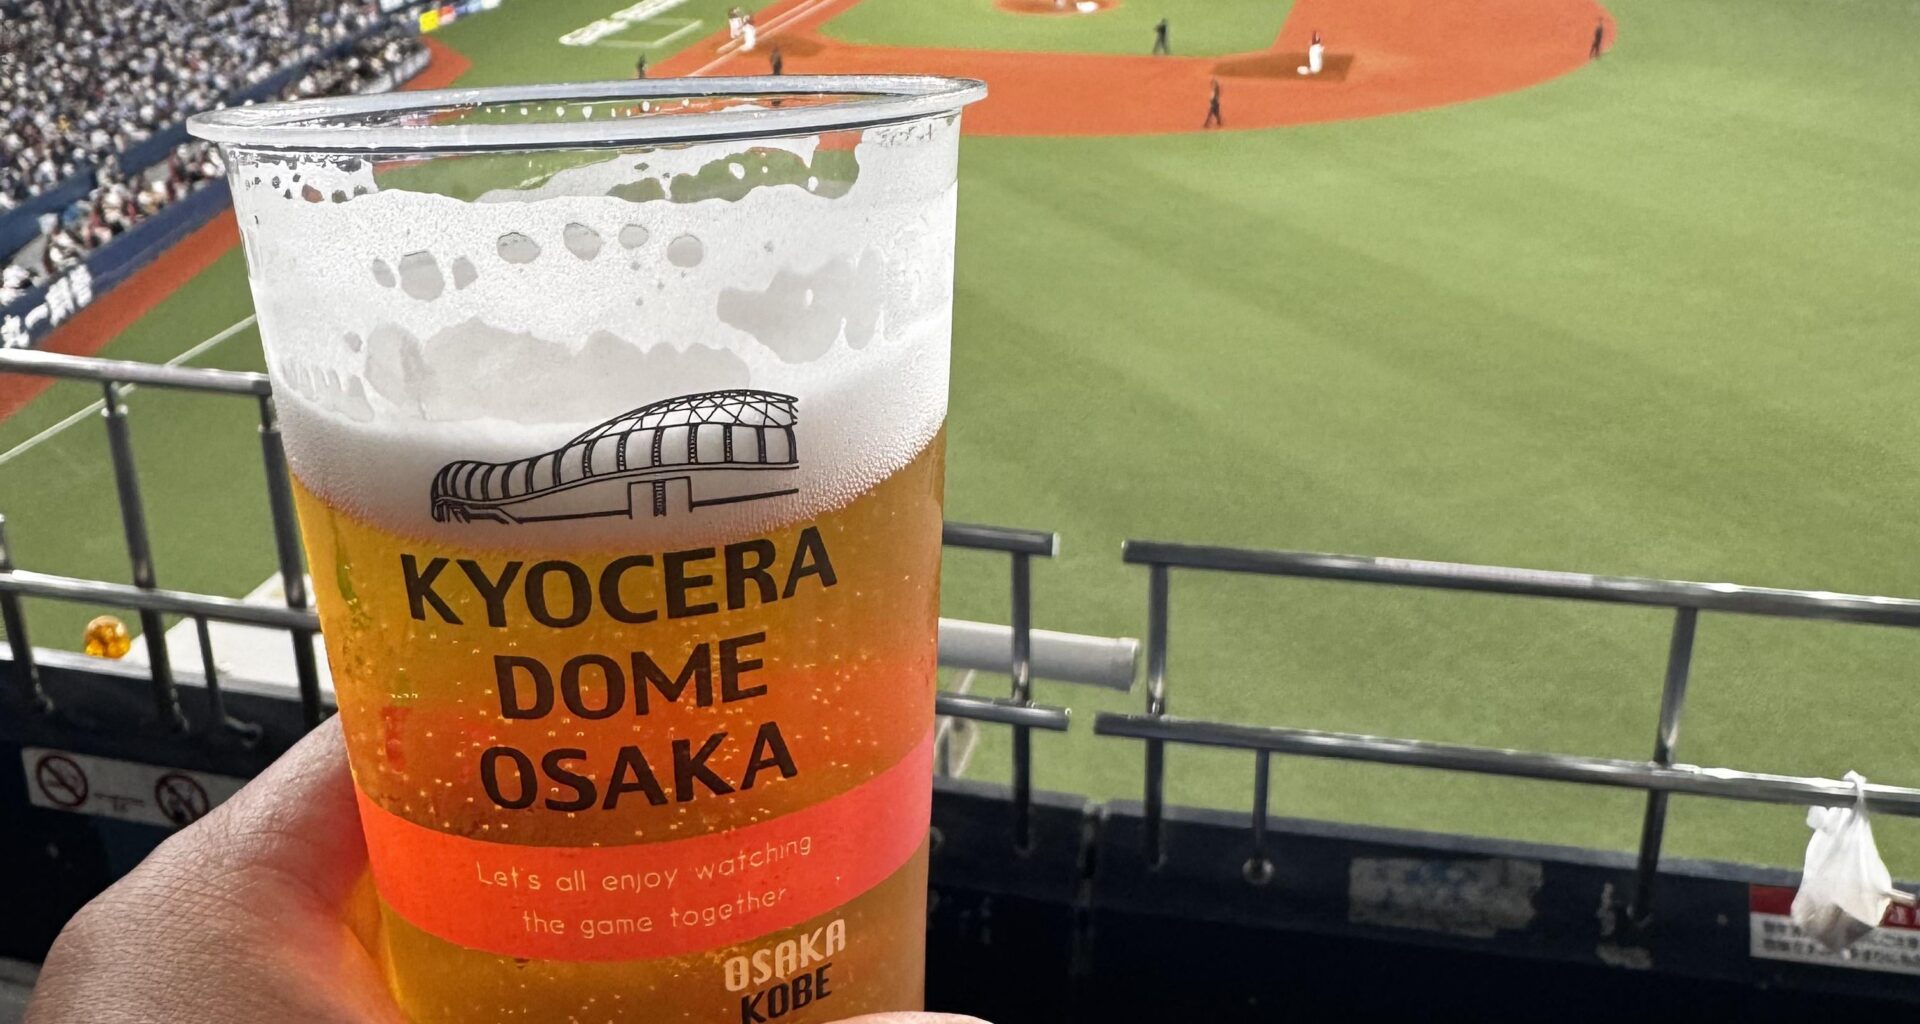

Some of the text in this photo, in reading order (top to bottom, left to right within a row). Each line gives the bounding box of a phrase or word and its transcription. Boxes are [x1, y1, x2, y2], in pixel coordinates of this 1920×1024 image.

[400, 526, 838, 629] KYOCERA
[493, 631, 768, 720] DOME
[480, 720, 798, 812] OSAKA
[476, 836, 812, 894] Let's all enjoy watching
[522, 887, 787, 939] the game together
[724, 918, 846, 992] OSAKA
[741, 962, 833, 1024] KOBE
